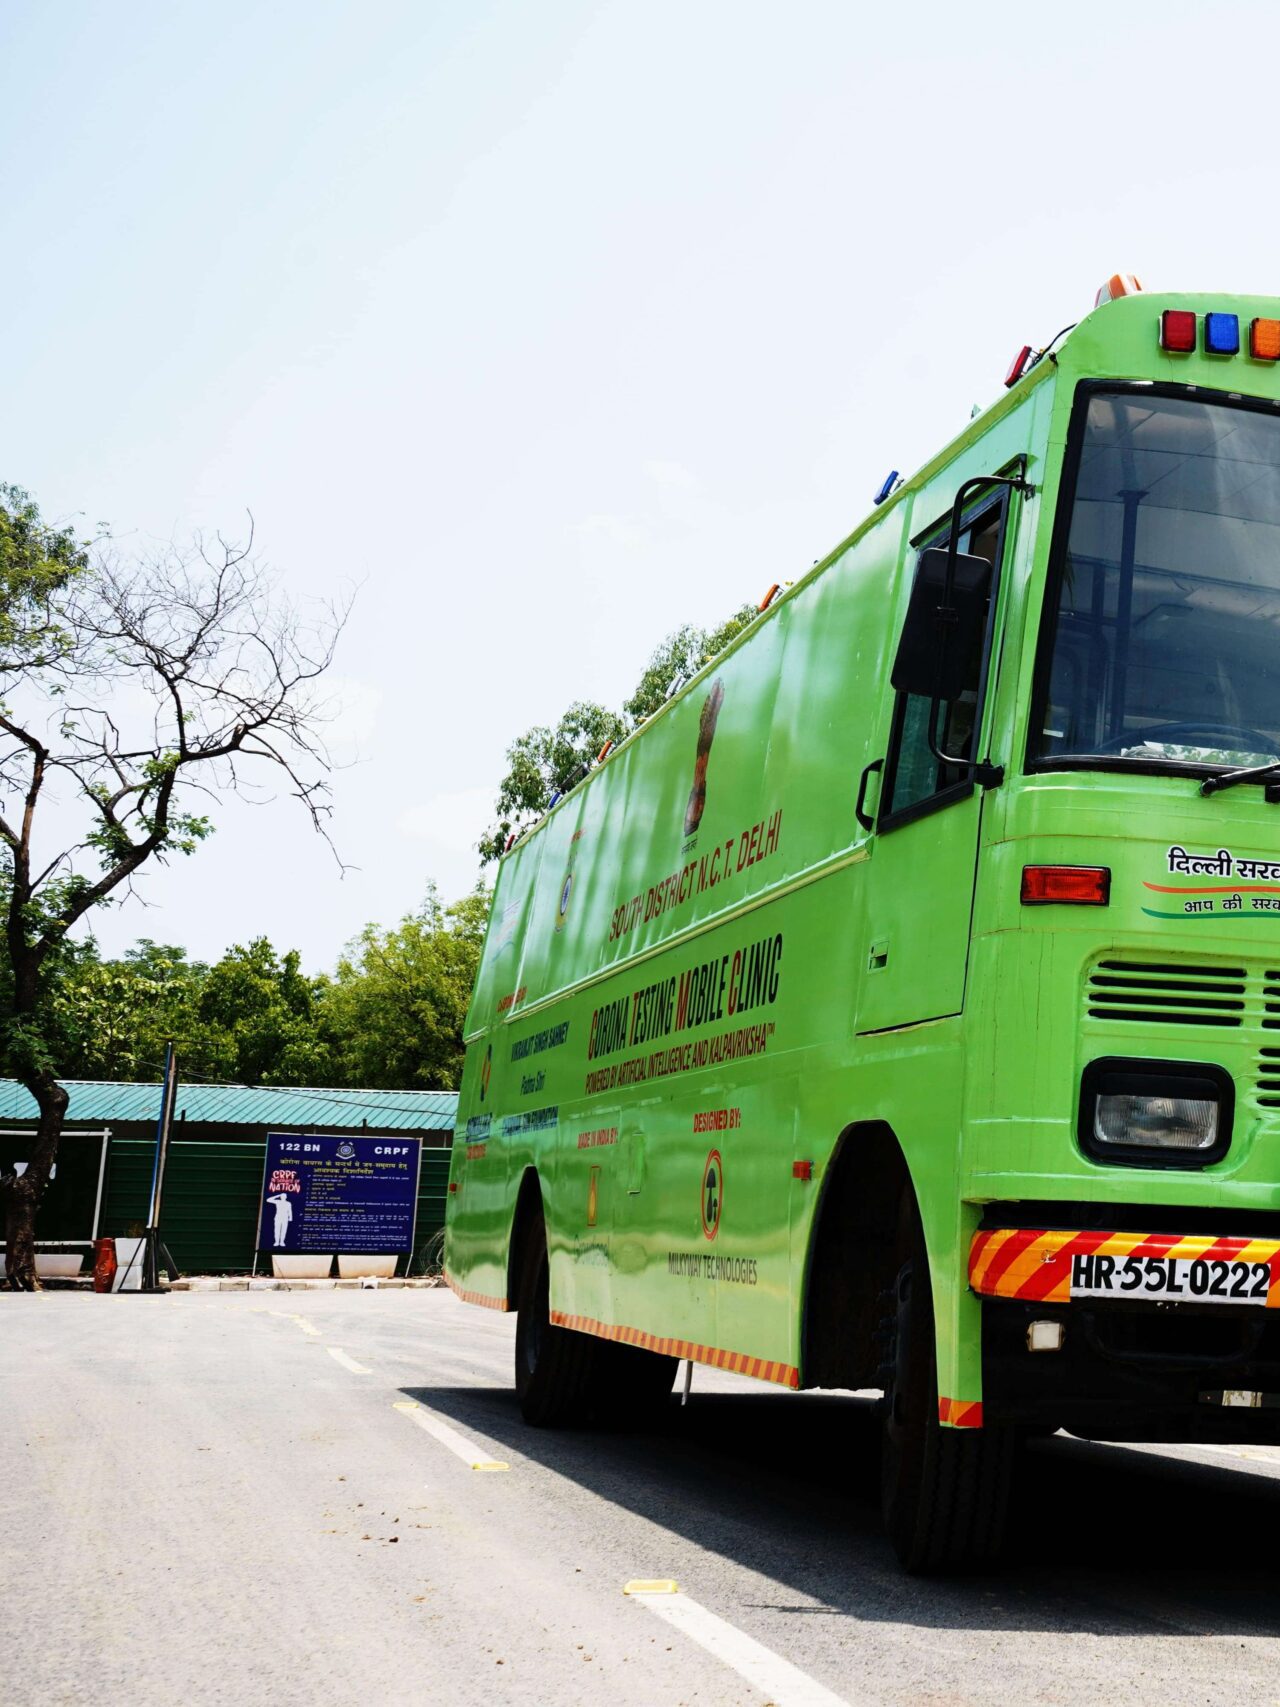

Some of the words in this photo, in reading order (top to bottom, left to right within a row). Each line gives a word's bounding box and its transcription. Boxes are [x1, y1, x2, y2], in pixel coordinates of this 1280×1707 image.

[1168, 846, 1232, 876] दिल्ली
[609, 893, 644, 942] SOUTH
[643, 860, 698, 924] DISTRICT
[736, 809, 783, 873] DELHI
[1184, 900, 1213, 913] आप
[1222, 893, 1242, 910] की
[588, 995, 630, 1061] CORONA
[629, 976, 676, 1047] TESTING
[675, 955, 729, 1032] MOBILE
[728, 933, 783, 1016] CLINIC
[585, 1067, 610, 1096] POWERED
[610, 1064, 618, 1089] BY
[618, 1056, 647, 1086] ARTIFICIAL
[648, 1044, 692, 1078] INTELLIGENCE
[691, 1039, 709, 1069] AND
[693, 1109, 727, 1133] DESIGNED
[729, 1107, 741, 1129] BY:
[280, 1143, 300, 1151] 122
[304, 1144, 320, 1152] BN
[374, 1146, 409, 1155] CRPF
[577, 1132, 590, 1150] MADE
[597, 1128, 610, 1146] INDIA
[272, 1170, 297, 1179] CRPF
[669, 1252, 702, 1278] MILKYWAY
[703, 1255, 758, 1285] TECHNOLOGIES
[1072, 1254, 1271, 1298] HR-55L-0222
